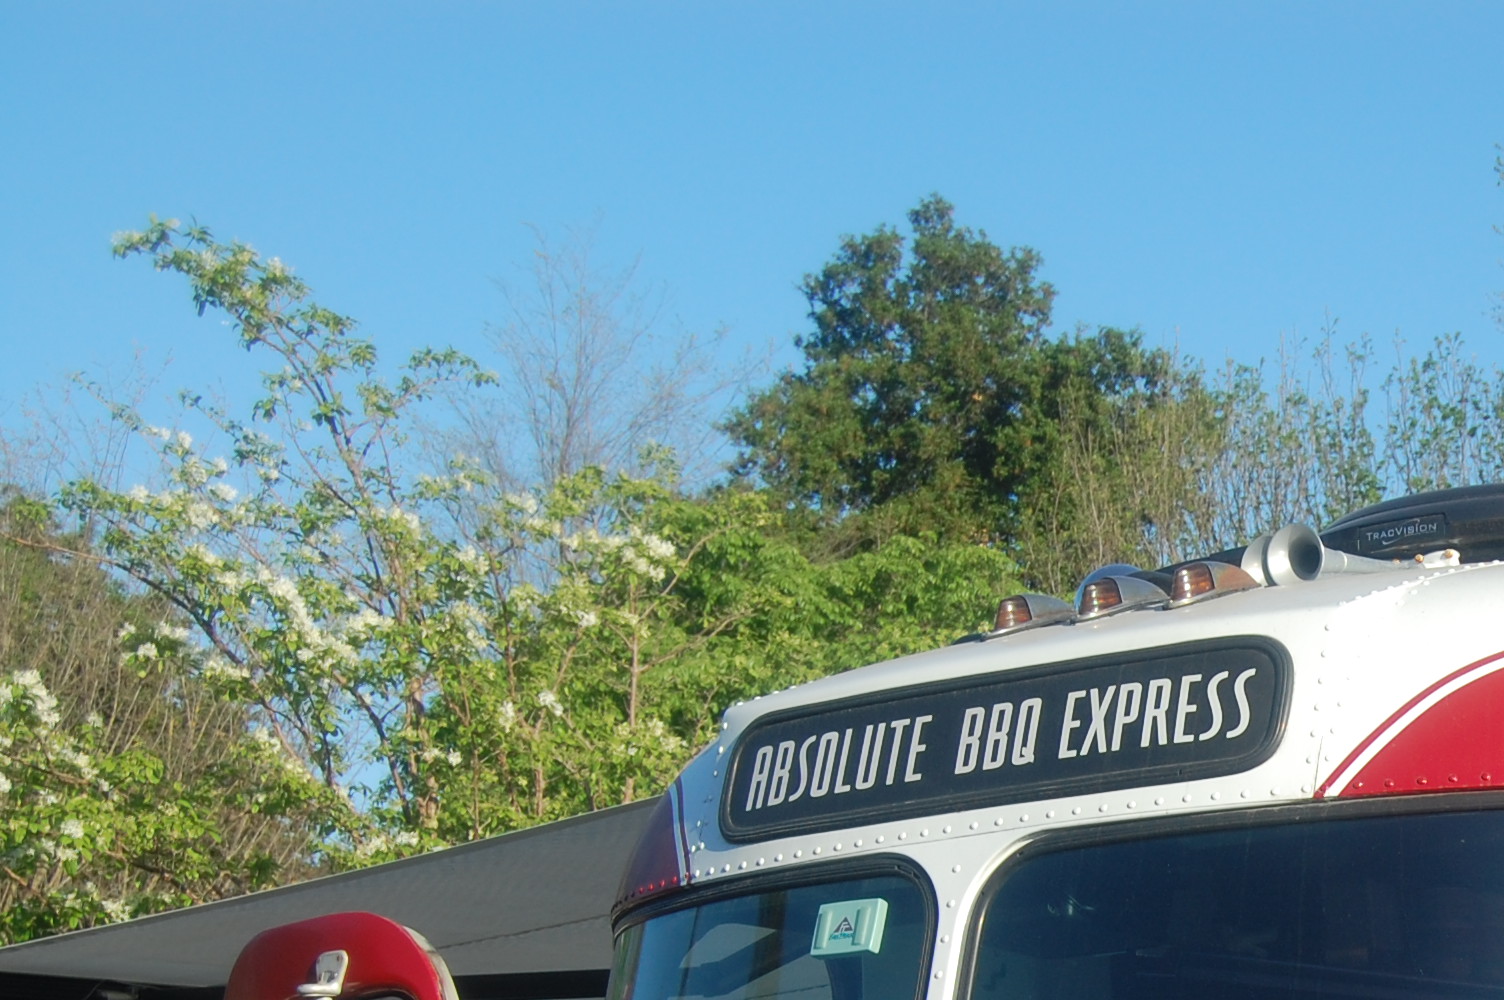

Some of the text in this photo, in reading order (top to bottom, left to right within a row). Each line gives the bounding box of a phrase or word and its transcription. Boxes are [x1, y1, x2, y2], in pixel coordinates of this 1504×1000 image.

[1365, 522, 1438, 541] TRACVISION
[745, 667, 1257, 812] ABSOLUTE BBQ EXPRESS
